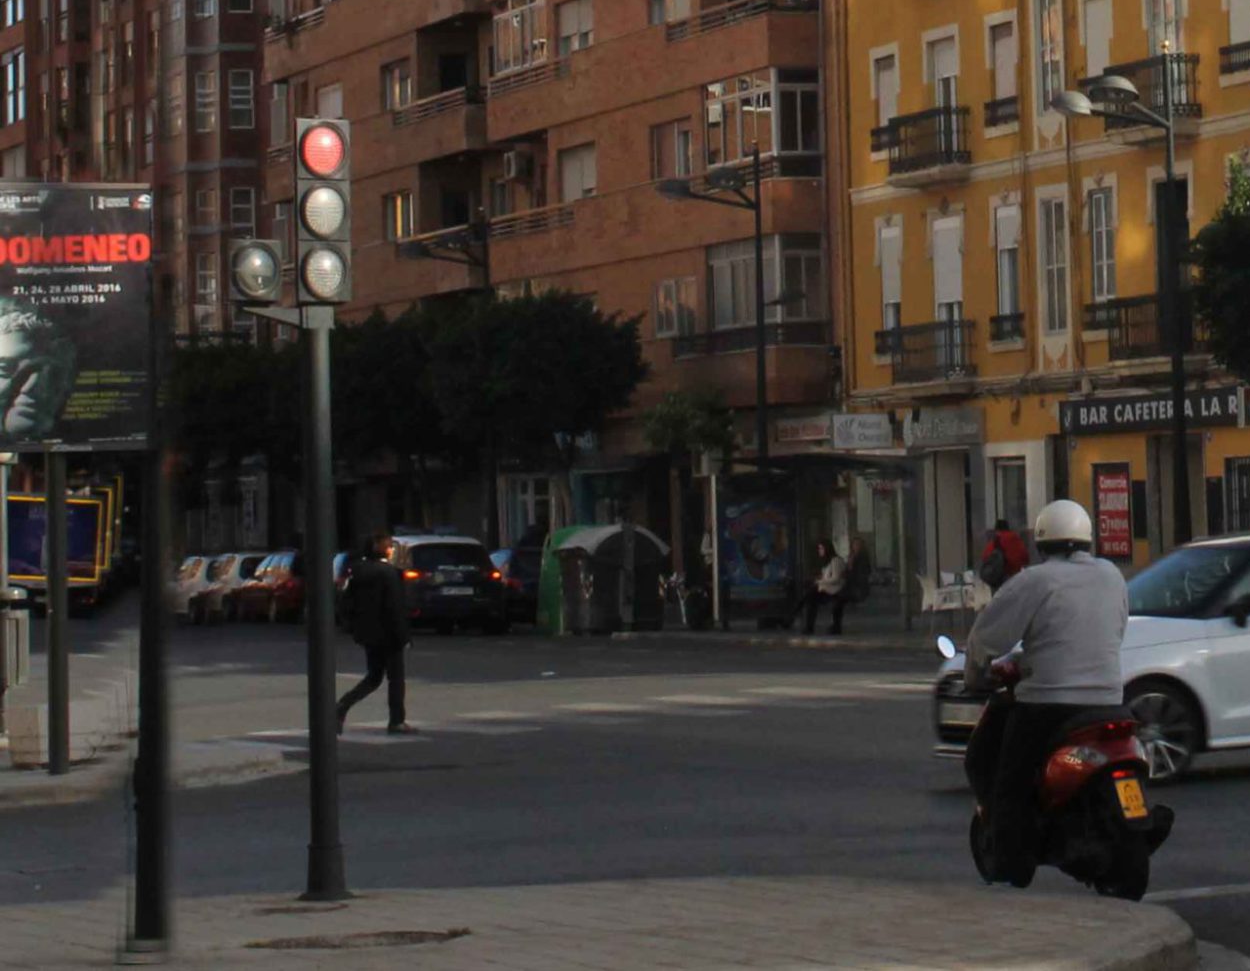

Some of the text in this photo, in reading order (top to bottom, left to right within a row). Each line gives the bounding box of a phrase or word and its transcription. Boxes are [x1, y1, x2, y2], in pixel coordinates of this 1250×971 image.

[64, 284, 95, 293] ABRIL
[98, 283, 121, 292] 2016
[51, 295, 79, 304] MAYO
[82, 294, 106, 303] 2016
[1080, 407, 1108, 425] BAR
[1114, 399, 1194, 422] CAFETERA
[1201, 396, 1221, 416] LA
